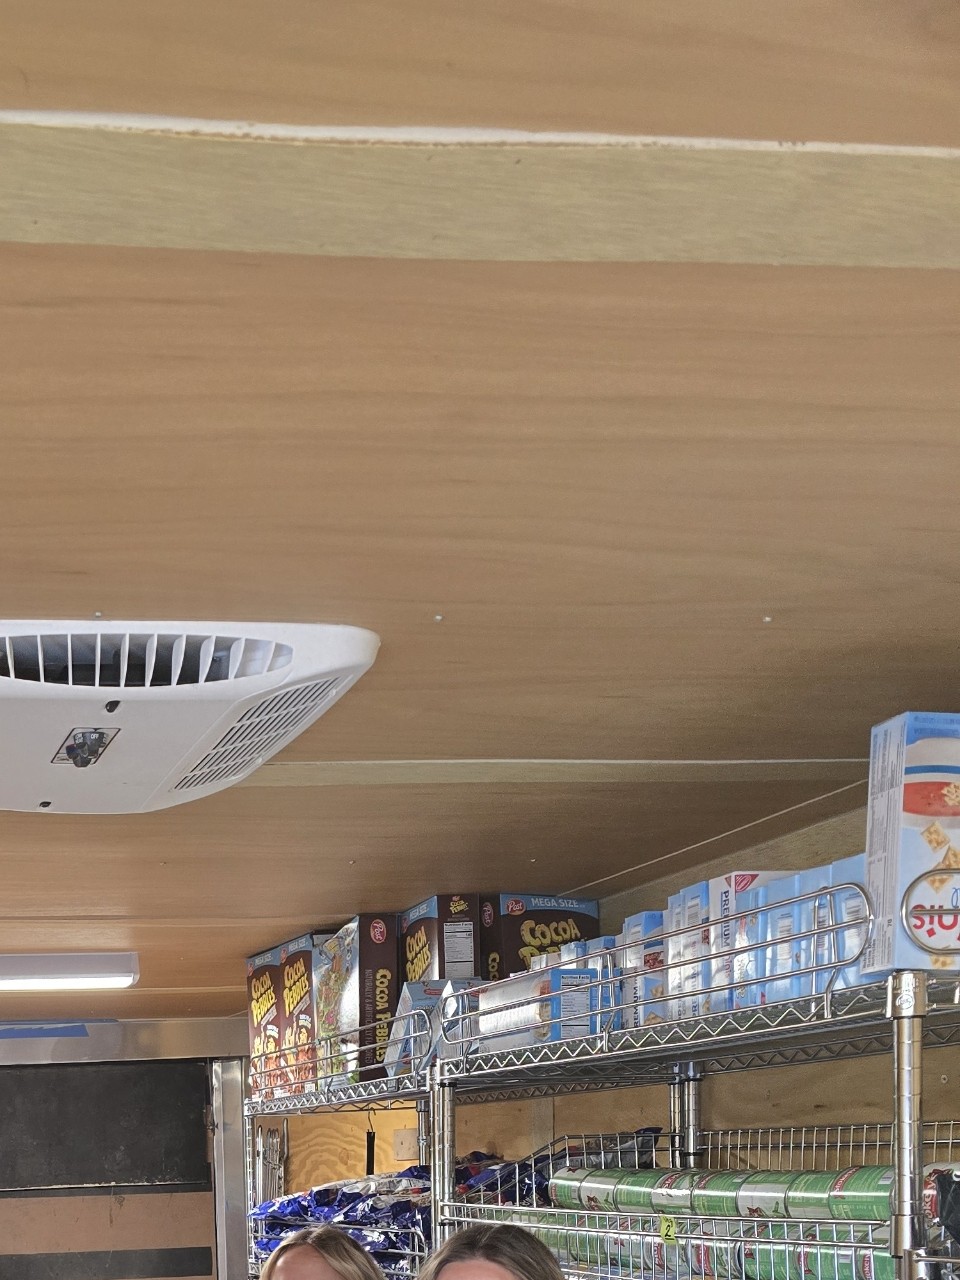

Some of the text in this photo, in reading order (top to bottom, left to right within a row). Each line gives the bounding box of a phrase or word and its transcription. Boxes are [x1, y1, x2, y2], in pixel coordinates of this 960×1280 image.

[507, 901, 524, 912] Post
[531, 897, 579, 908] MEGA SIZE
[374, 922, 384, 942] Post
[405, 925, 428, 960] COCOA
[519, 918, 582, 947] COCOA
[251, 971, 272, 999] COCOA
[285, 957, 306, 988] COCOA
[283, 973, 310, 1017] PEBBLES
[376, 968, 392, 1011] COCOA
[251, 985, 277, 1028] PEBBLES
